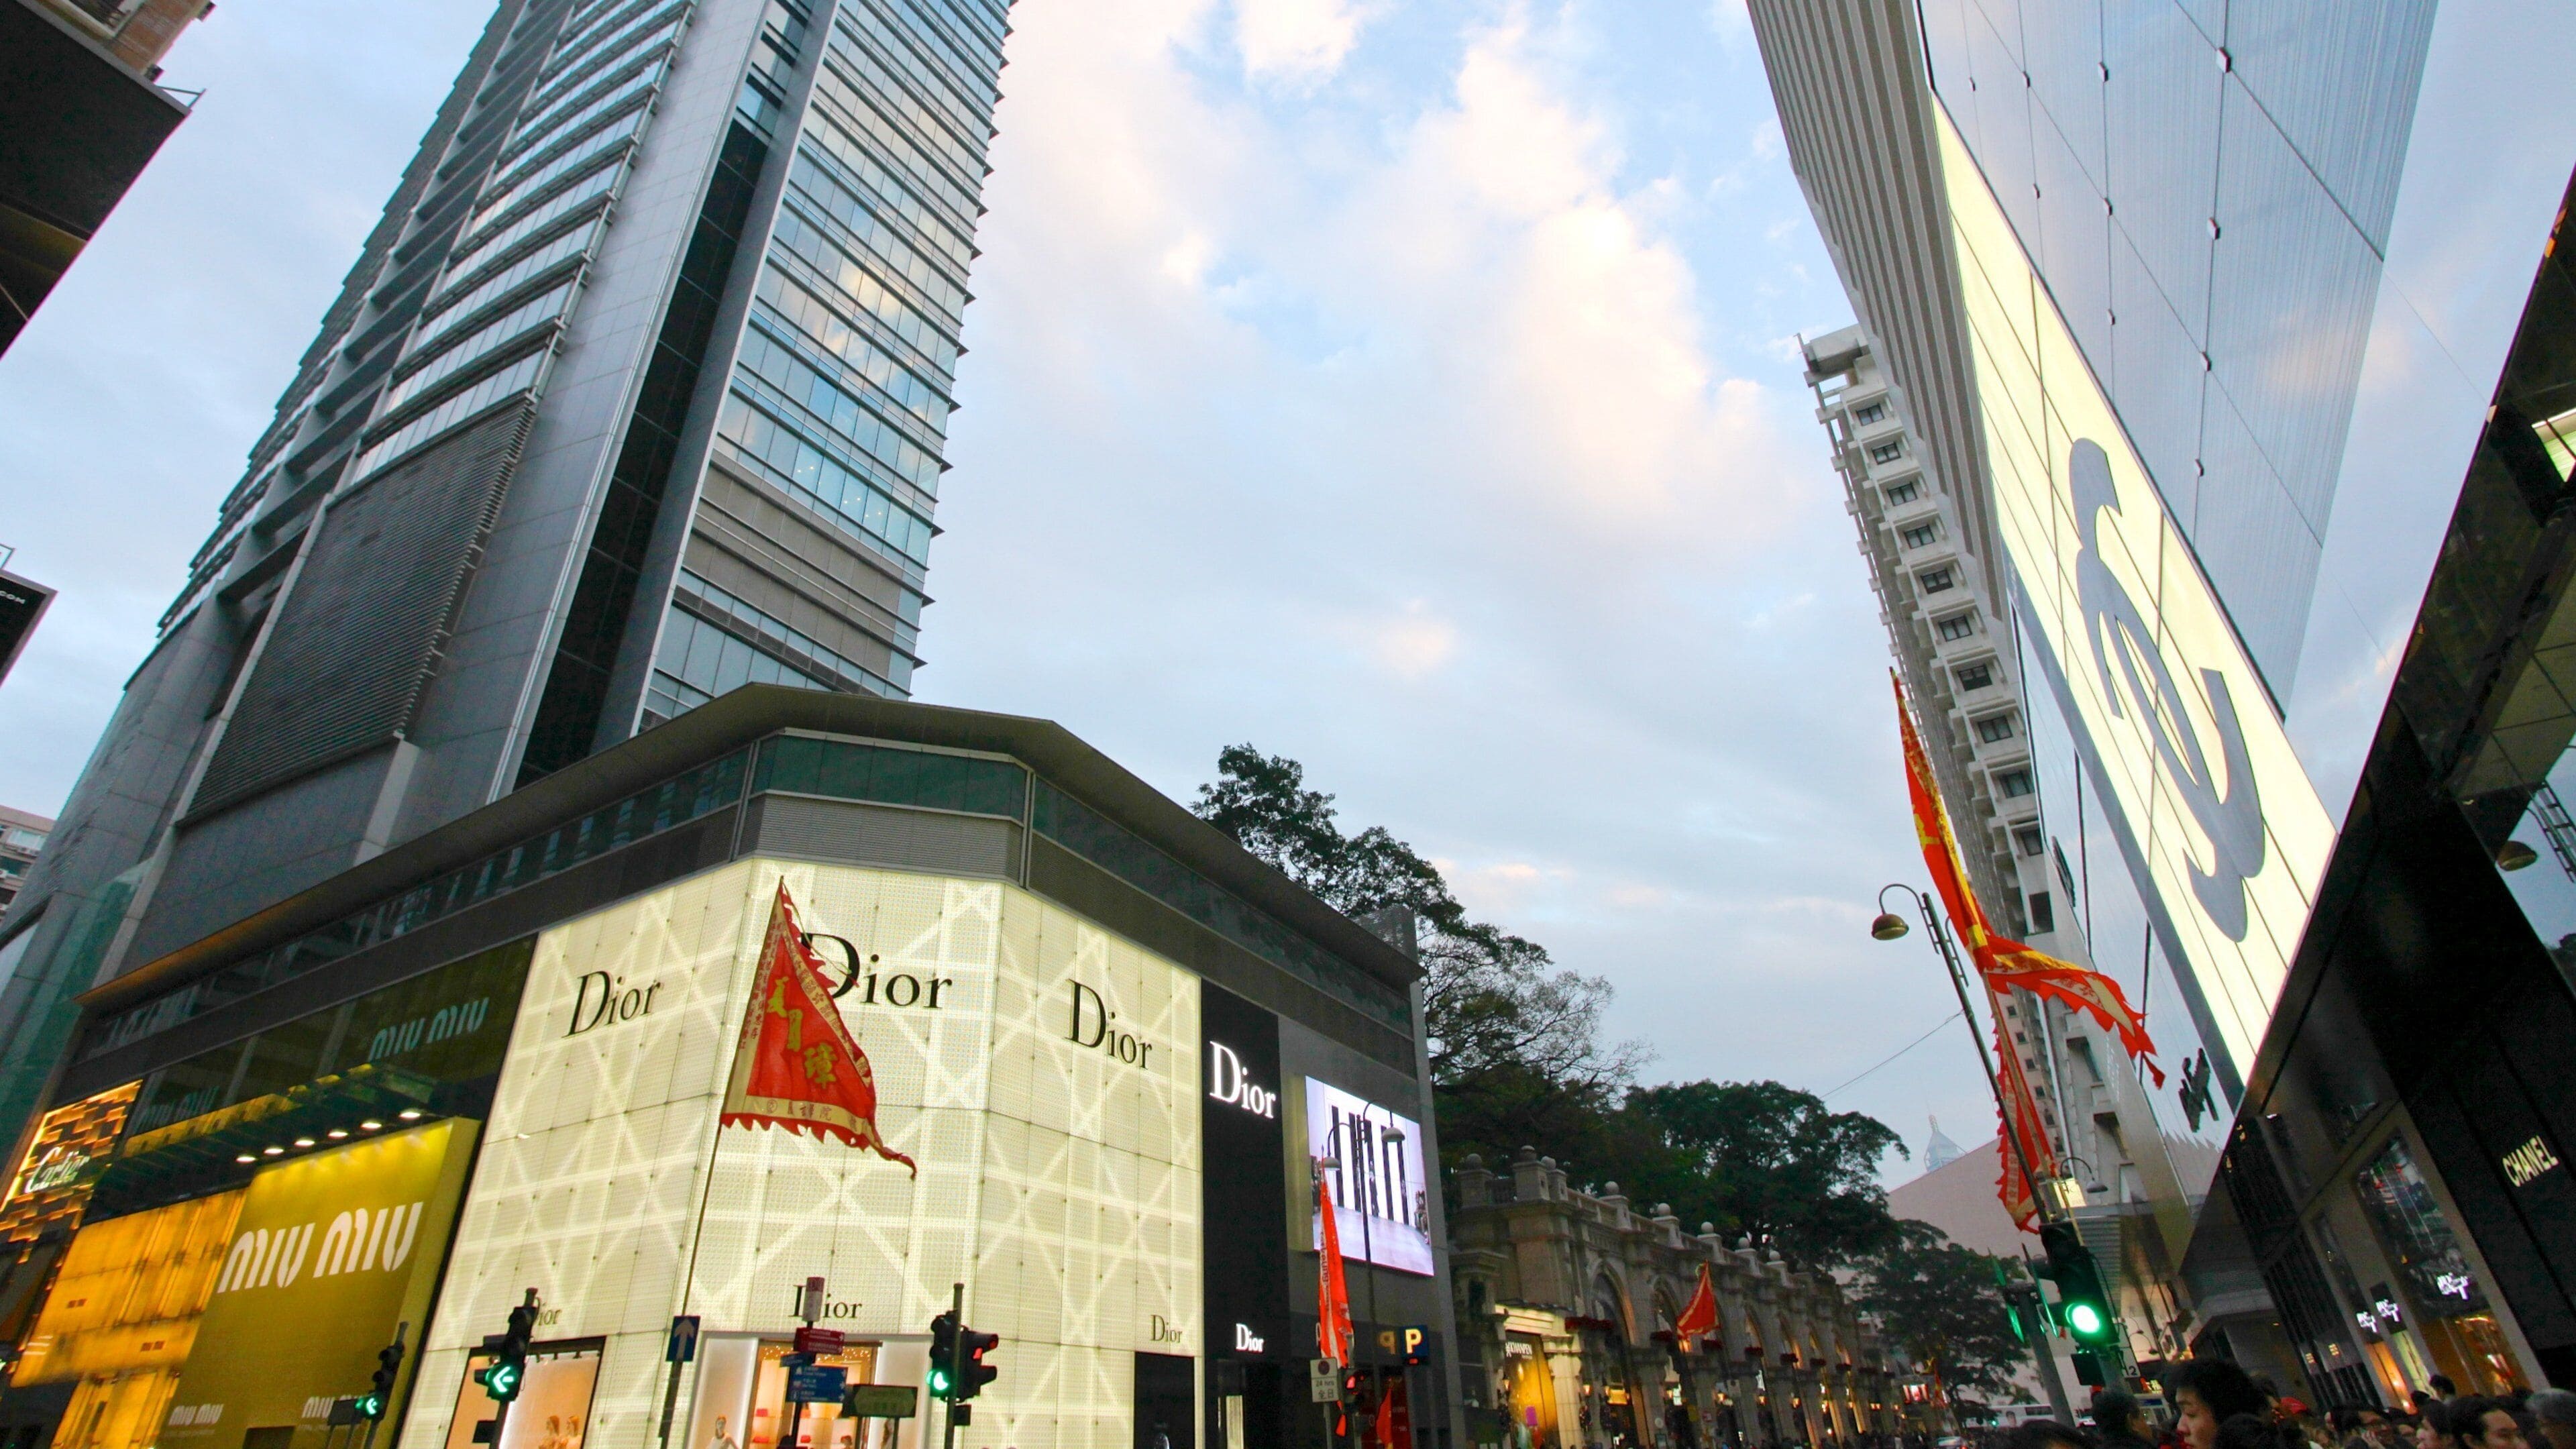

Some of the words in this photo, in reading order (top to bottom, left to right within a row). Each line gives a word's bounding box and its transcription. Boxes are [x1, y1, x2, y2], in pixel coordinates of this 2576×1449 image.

[801, 932, 953, 1008] Dior
[561, 971, 661, 1038] Dior
[1065, 978, 1152, 1070] Dior
[1209, 1040, 1276, 1118] Dior
[24, 1146, 91, 1193] Cartier
[2502, 1135, 2559, 1187] CHANEL
[1150, 1314, 1183, 1344] Dior
[1235, 1323, 1265, 1353] Dior
[1405, 1328, 1422, 1354] P
